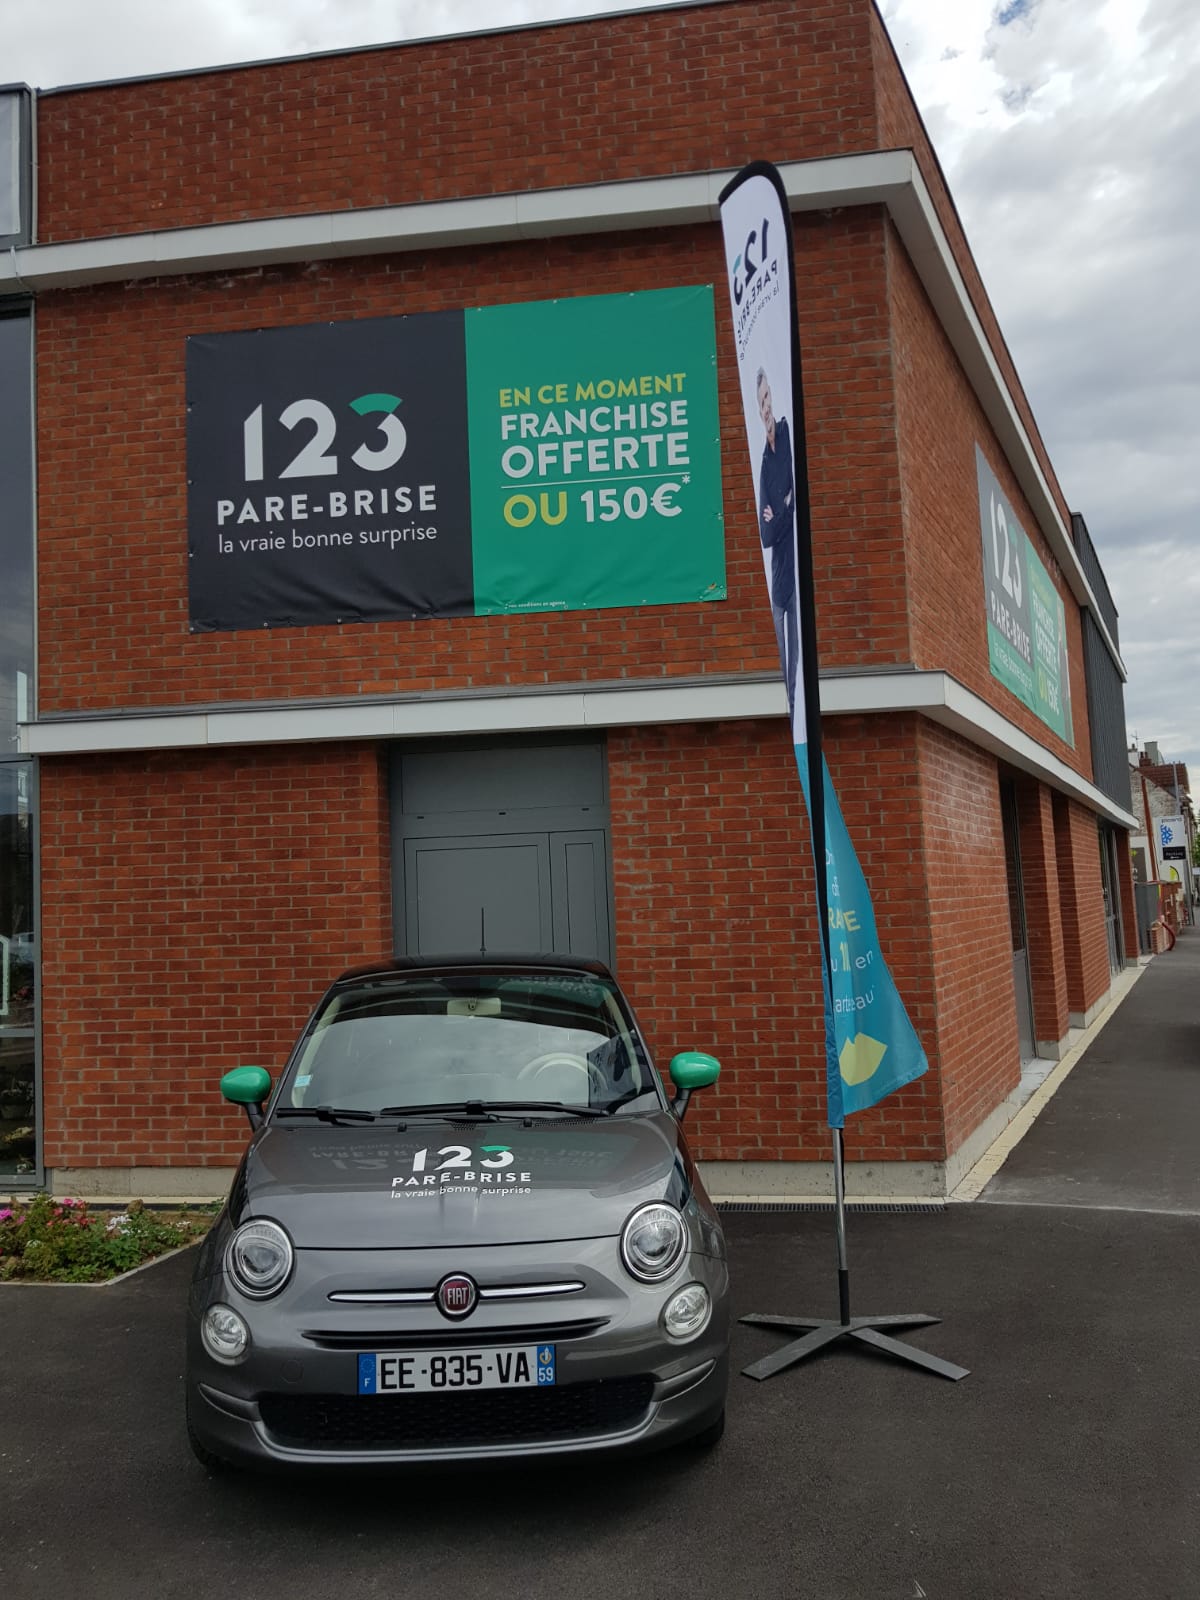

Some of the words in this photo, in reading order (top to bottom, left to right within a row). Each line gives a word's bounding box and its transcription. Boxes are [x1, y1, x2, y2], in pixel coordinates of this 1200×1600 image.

[499, 386, 531, 408] EN
[537, 383, 569, 404] CE
[575, 372, 688, 402] MOMENT
[243, 392, 407, 482] 123
[501, 399, 689, 441] FRANCHISE
[501, 431, 690, 479] OFFERTE
[216, 484, 437, 526] PARE-BRISE
[503, 491, 568, 528] OU
[218, 533, 234, 554] la
[239, 530, 287, 552] vraie
[291, 528, 354, 549] bonne
[358, 520, 438, 550] surprise
[990, 489, 1023, 609] 123
[855, 950, 873, 969] en
[412, 1145, 514, 1172] 123
[391, 1171, 532, 1187] PARE-BRISE
[391, 1190, 401, 1199] la
[405, 1188, 436, 1198] vraie
[440, 1185, 478, 1195] bonne
[481, 1185, 531, 1197] surprise
[447, 1286, 469, 1305] FIAT
[364, 1377, 371, 1388] F
[538, 1366, 554, 1383] 59
